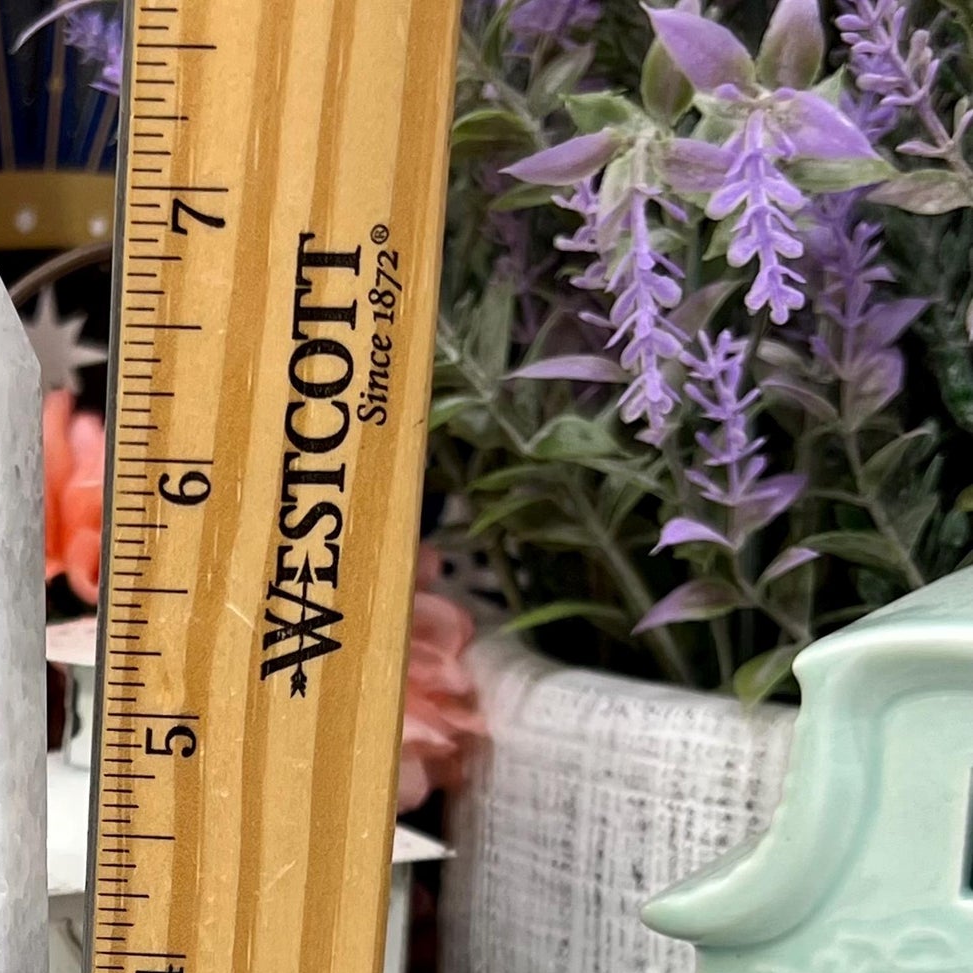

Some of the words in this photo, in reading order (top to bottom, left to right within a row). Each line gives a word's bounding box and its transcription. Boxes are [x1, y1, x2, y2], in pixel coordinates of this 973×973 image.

[171, 197, 226, 236] 7
[357, 333, 393, 426] Since
[261, 232, 361, 681] WESTCOTT
[158, 470, 212, 506] 6
[145, 724, 197, 758] 5
